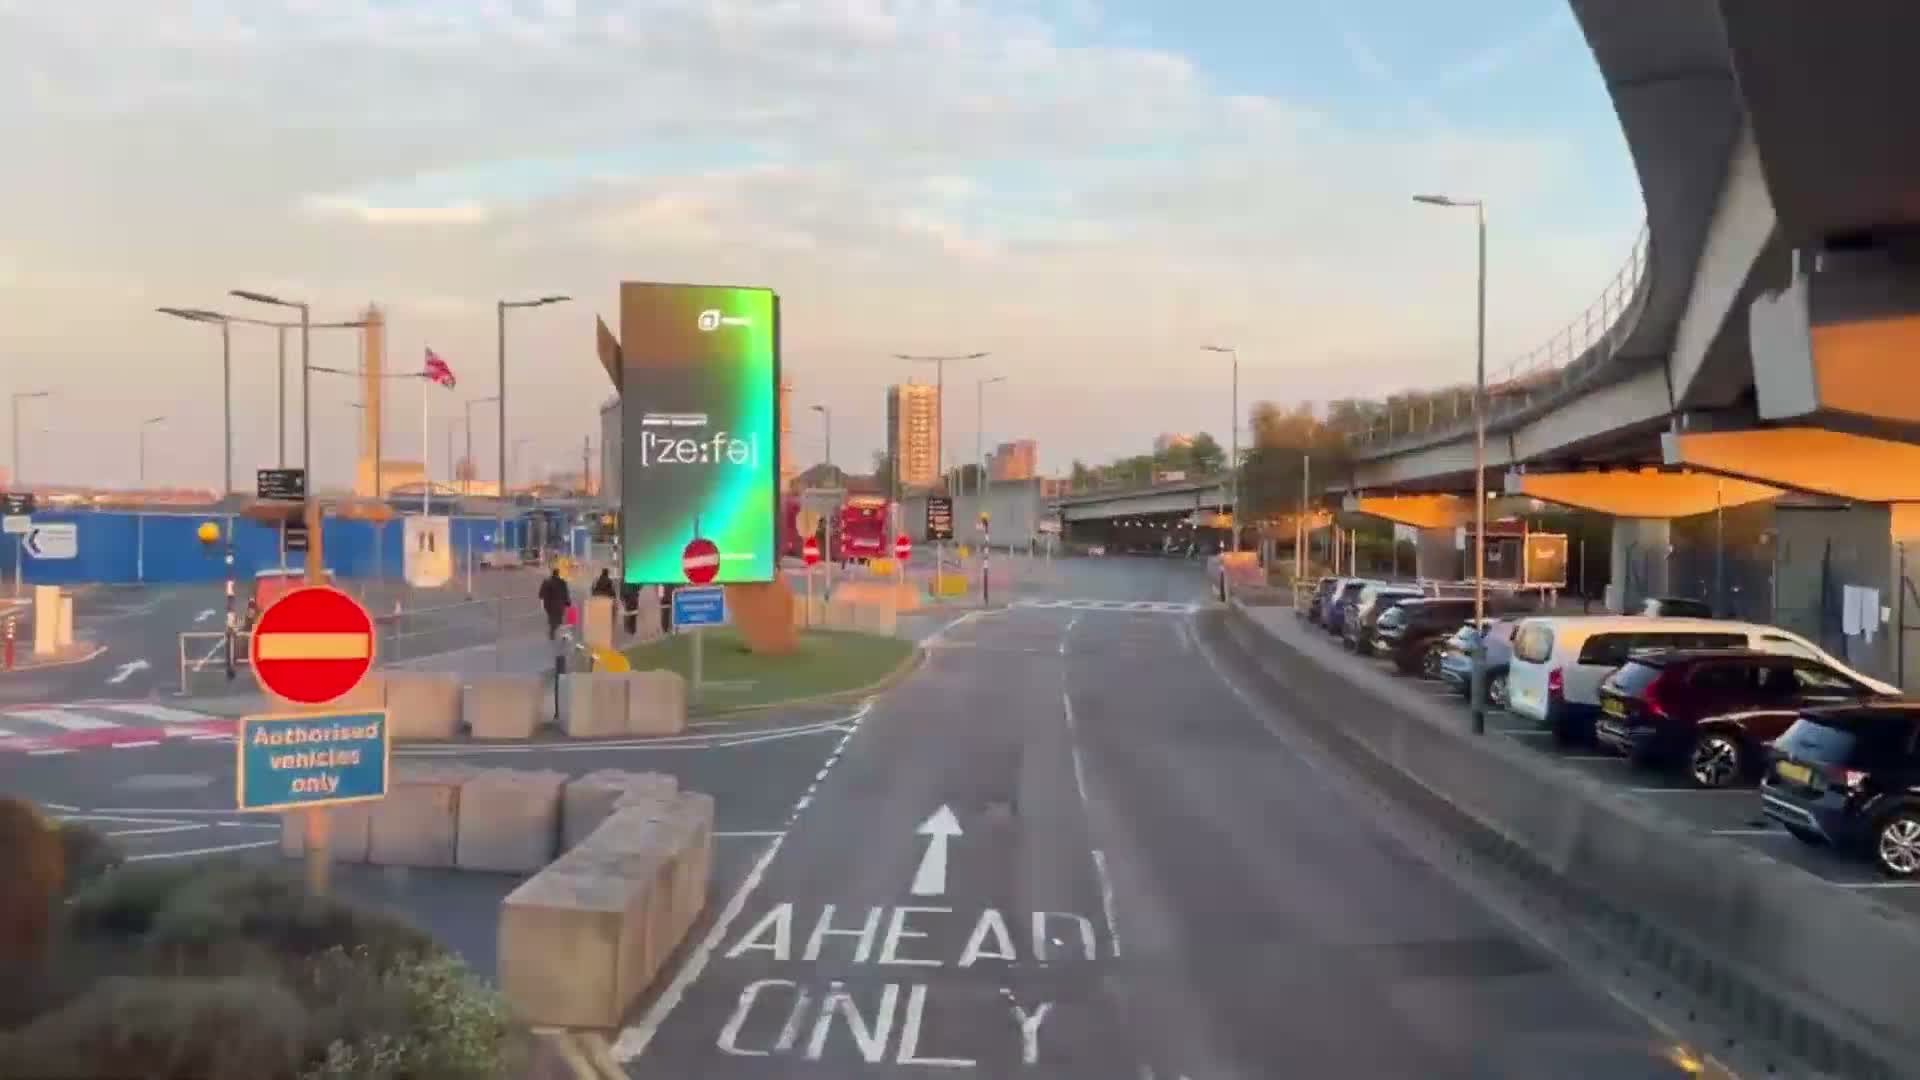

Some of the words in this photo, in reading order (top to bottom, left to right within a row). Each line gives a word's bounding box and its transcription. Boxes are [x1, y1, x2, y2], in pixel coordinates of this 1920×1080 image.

[253, 721, 378, 746] Authorised
[271, 748, 360, 769] vehicles
[291, 772, 339, 794] only
[724, 902, 1096, 967] AHEAD
[716, 979, 1053, 1066] ONLY
